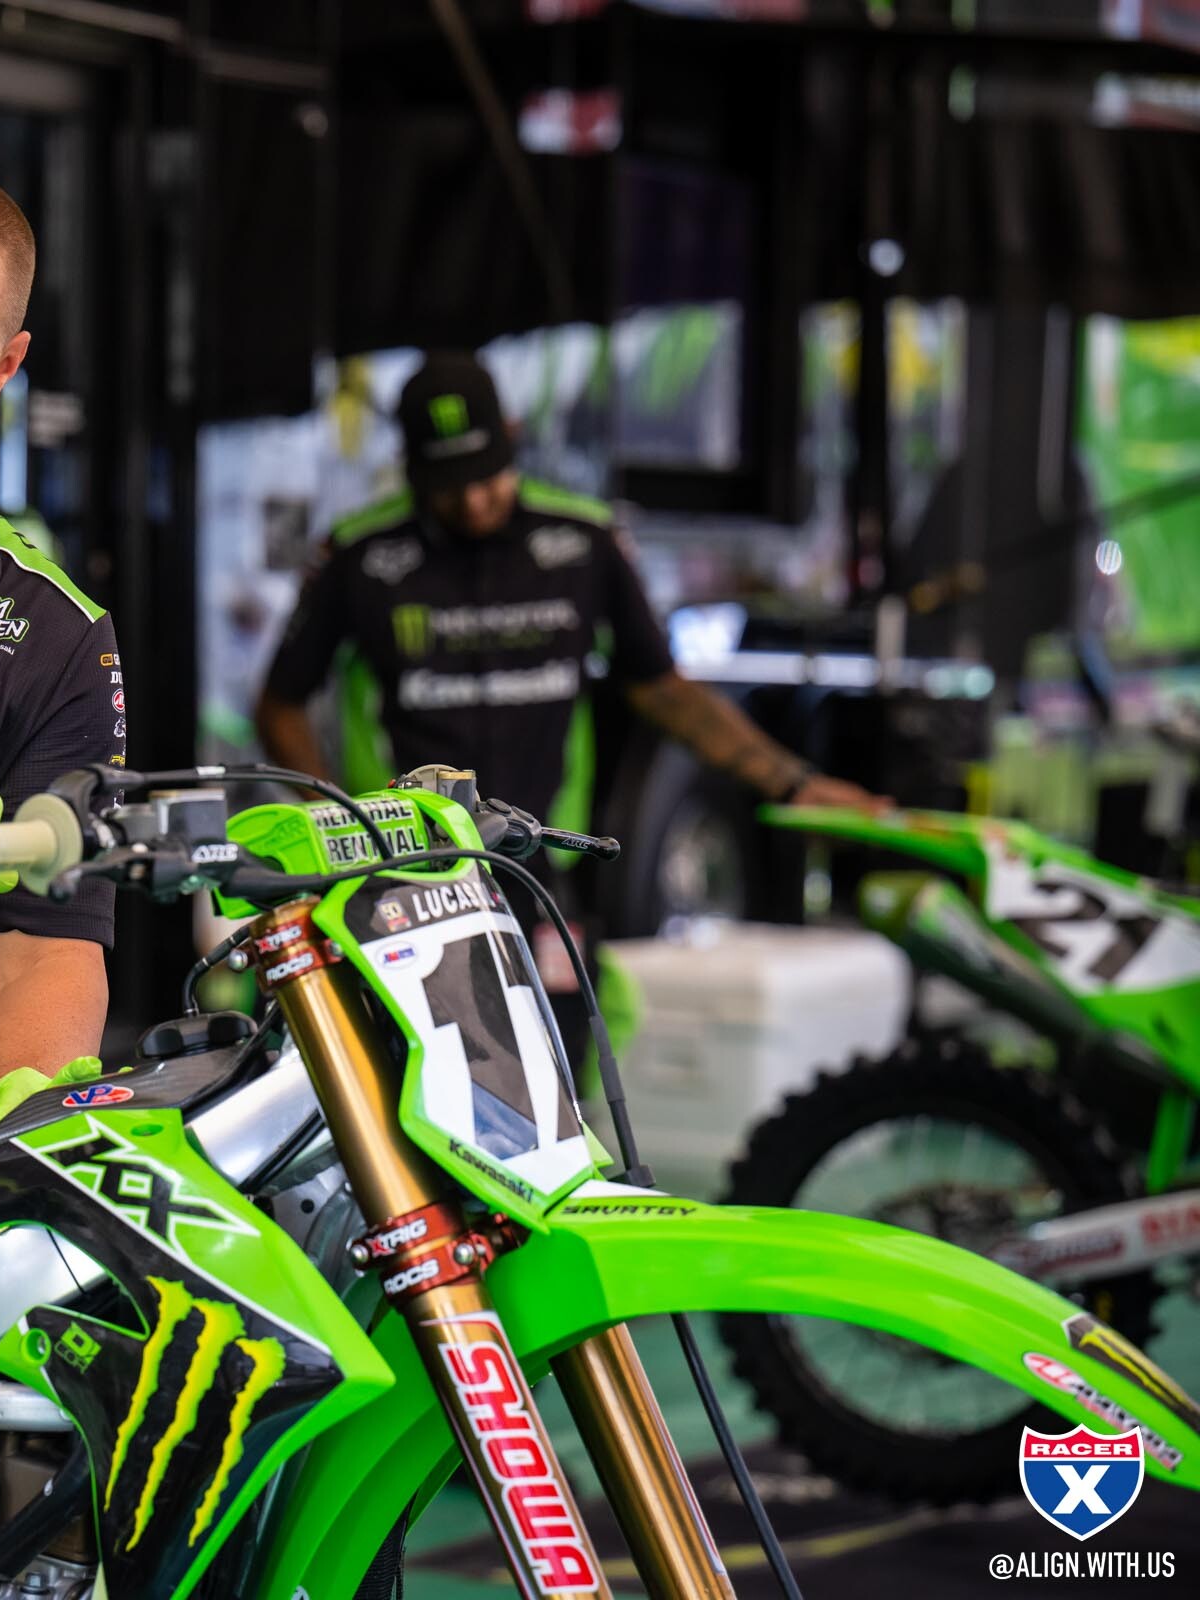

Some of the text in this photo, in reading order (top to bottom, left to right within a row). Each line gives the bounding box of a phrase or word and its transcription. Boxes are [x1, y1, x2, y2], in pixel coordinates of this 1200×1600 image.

[70, 1084, 113, 1105] VP
[449, 1139, 533, 1203] Kawasaki
[366, 1218, 428, 1257] XTRIG
[384, 1258, 440, 1295] ROCS
[443, 1343, 597, 1592] SHOWA
